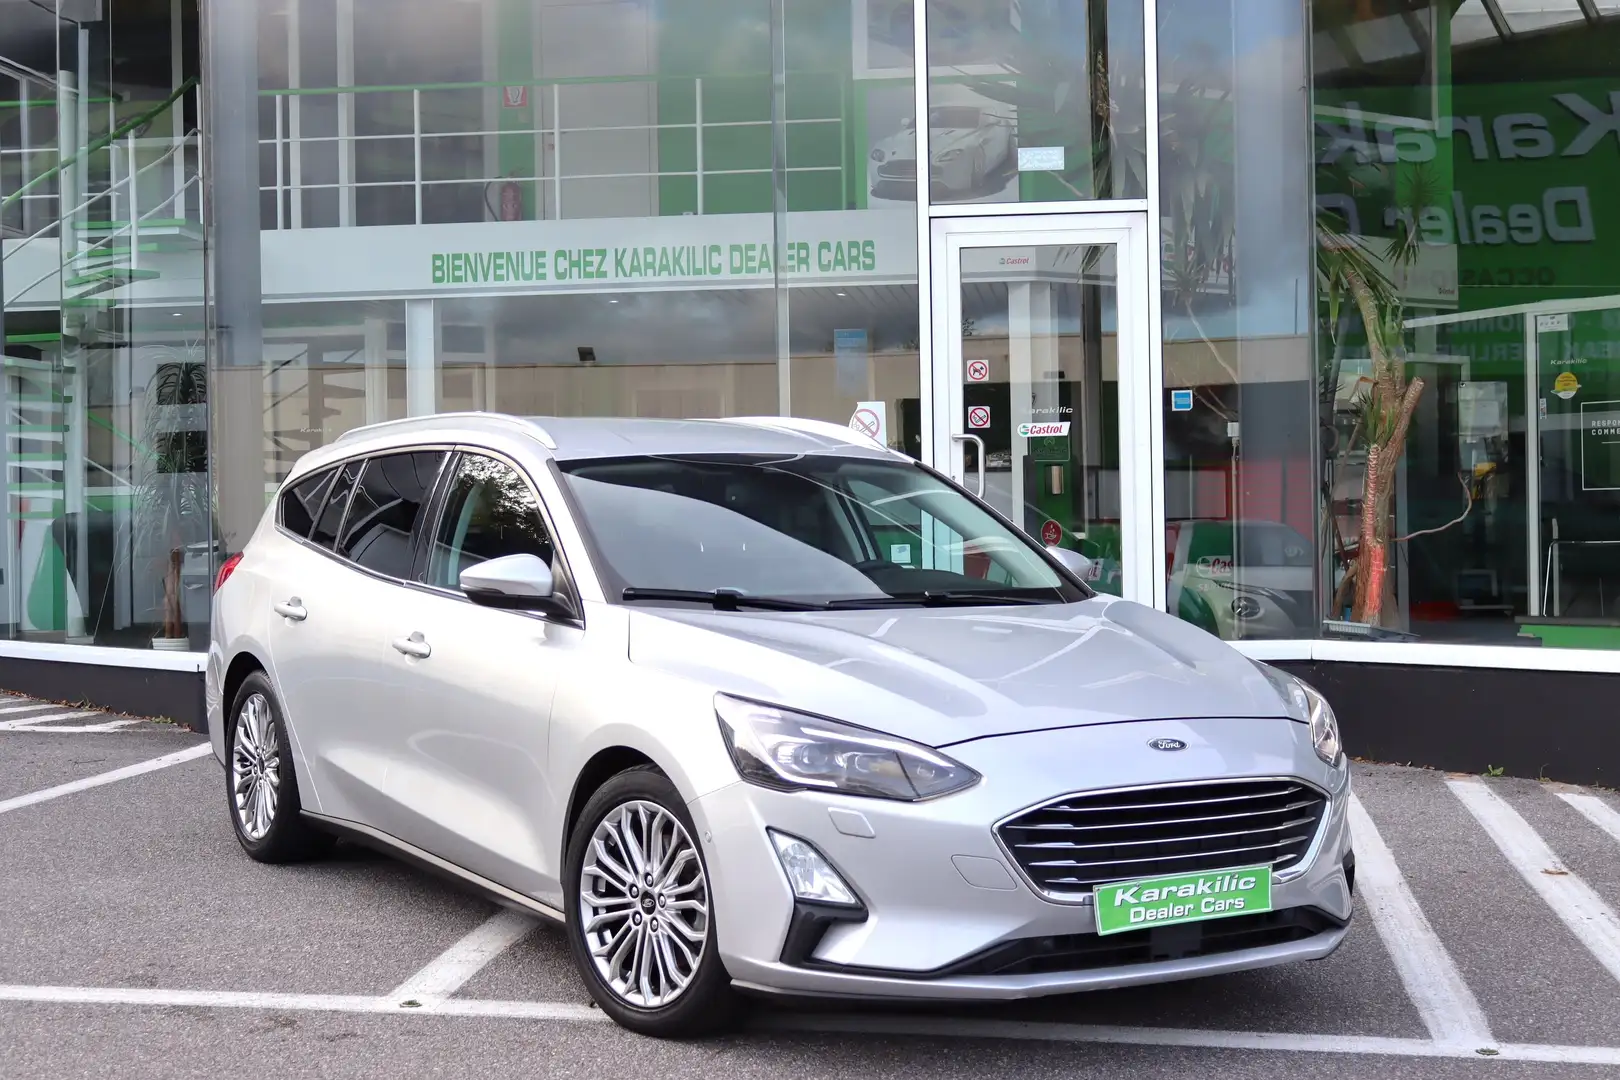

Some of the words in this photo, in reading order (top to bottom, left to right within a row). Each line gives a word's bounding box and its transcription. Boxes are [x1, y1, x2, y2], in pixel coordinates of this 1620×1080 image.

[432, 250, 547, 283] BIENVENUE
[554, 248, 608, 279] CHEZ
[614, 244, 722, 278] KARAKILIC
[729, 241, 810, 275] DEAER
[818, 239, 876, 271] CARS
[1005, 256, 1030, 265] Castrol
[1025, 406, 1074, 414] arakilic
[1030, 424, 1063, 435] Castrol
[1591, 428, 1620, 436] COMME
[1113, 872, 1256, 907] Karakilic
[1129, 902, 1194, 923] Dealer
[1200, 897, 1245, 913] Cars
